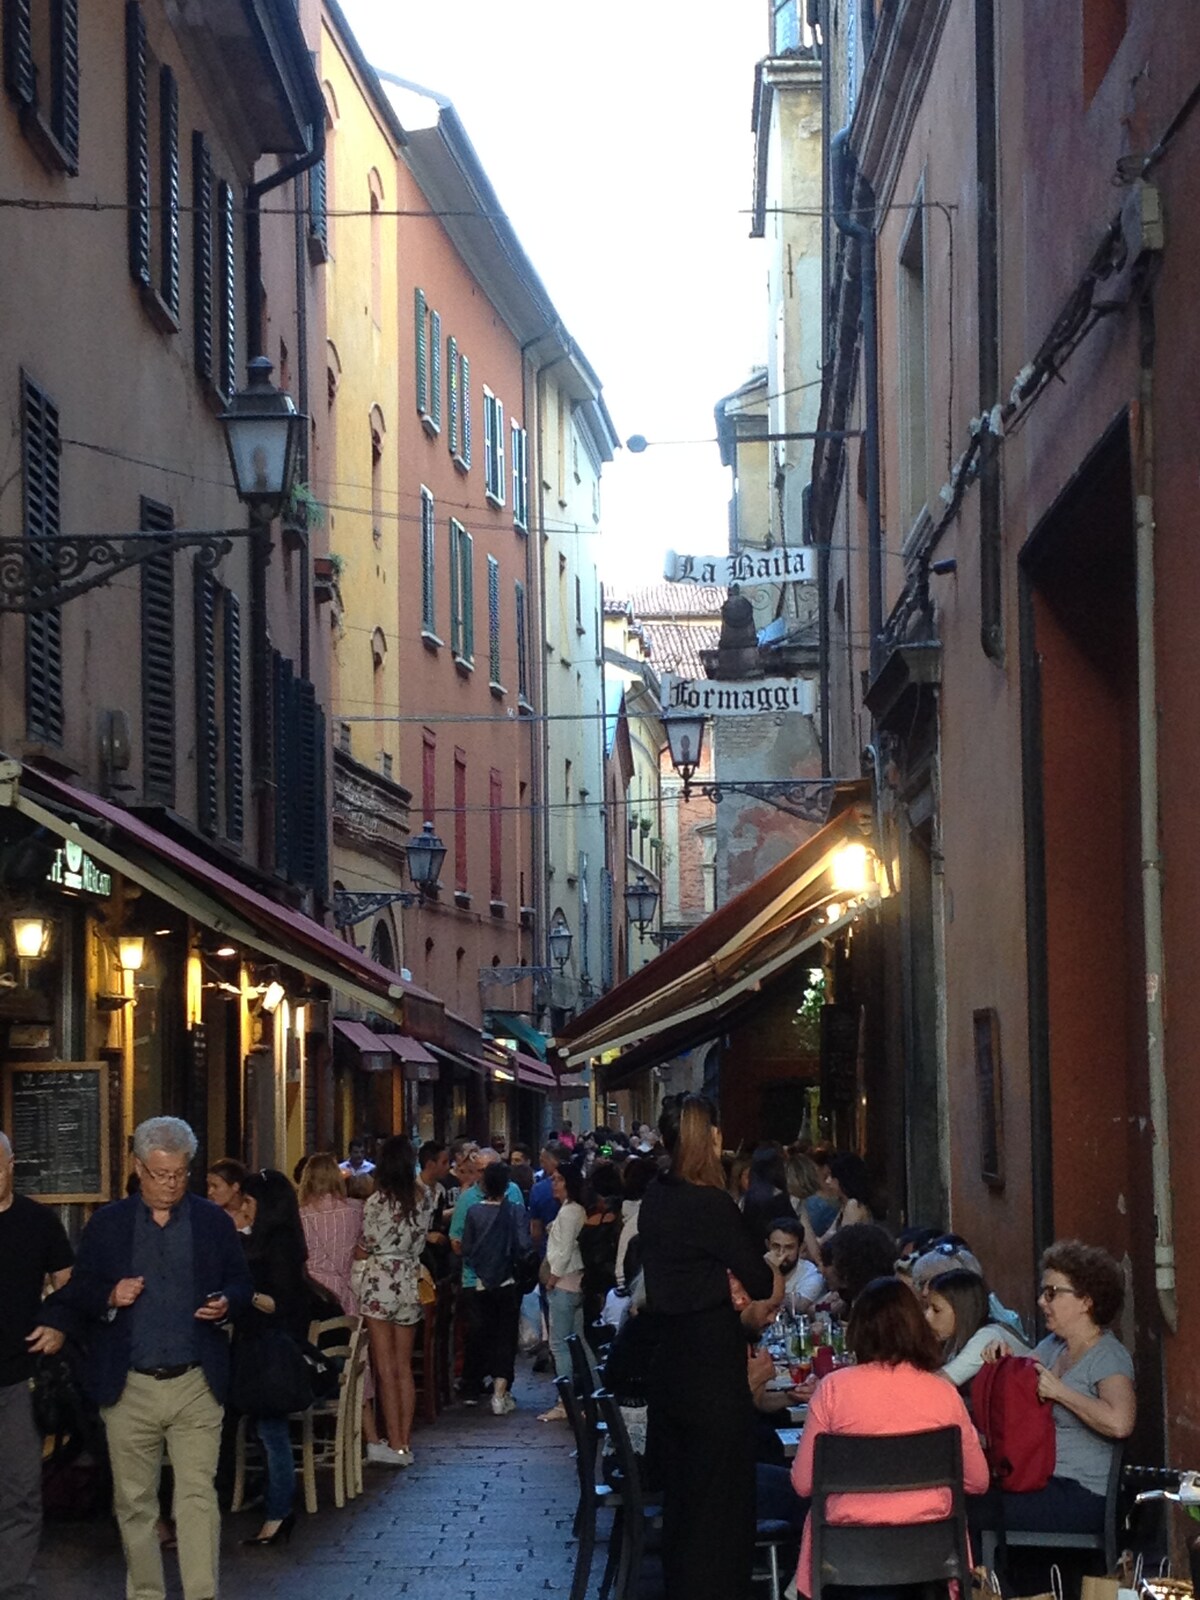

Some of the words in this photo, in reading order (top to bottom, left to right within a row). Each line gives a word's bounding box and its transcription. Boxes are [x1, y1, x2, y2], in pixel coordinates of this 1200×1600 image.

[678, 555, 715, 584] La
[727, 550, 805, 584] Baita
[669, 680, 800, 712] Formaggi
